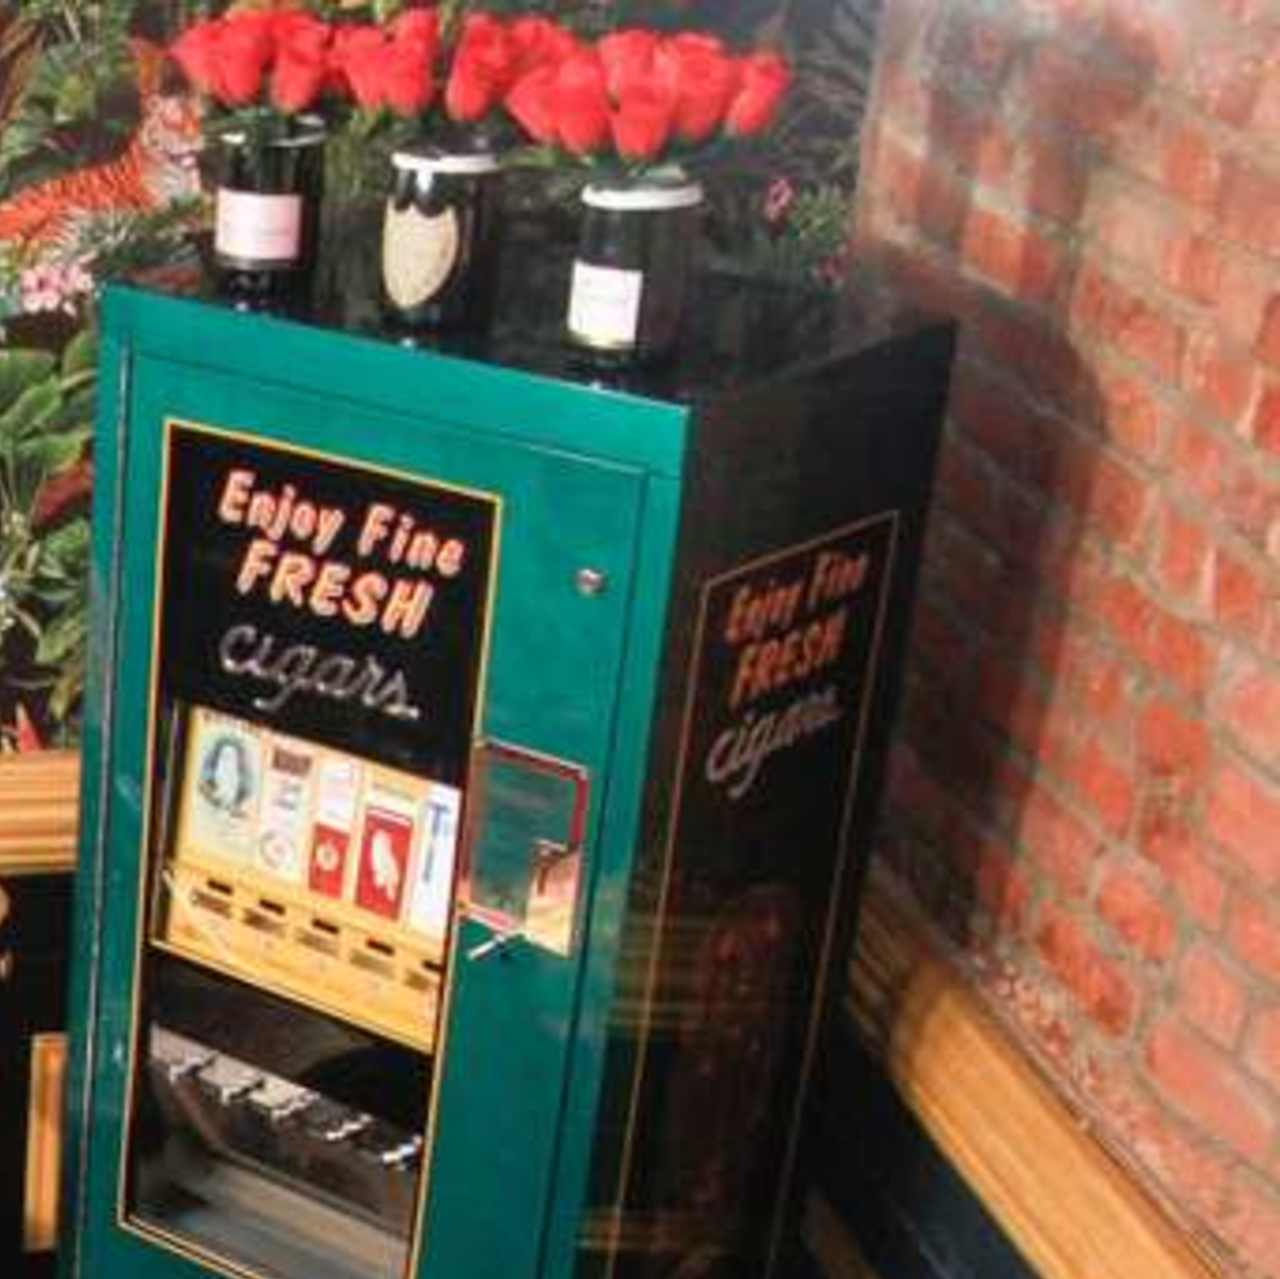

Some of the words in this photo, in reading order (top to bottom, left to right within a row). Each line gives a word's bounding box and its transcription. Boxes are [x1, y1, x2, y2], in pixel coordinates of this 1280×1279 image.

[219, 468, 344, 555] Enjoy
[358, 504, 466, 577] Fine
[236, 539, 435, 640] FRESH
[729, 609, 845, 707] FRESH
